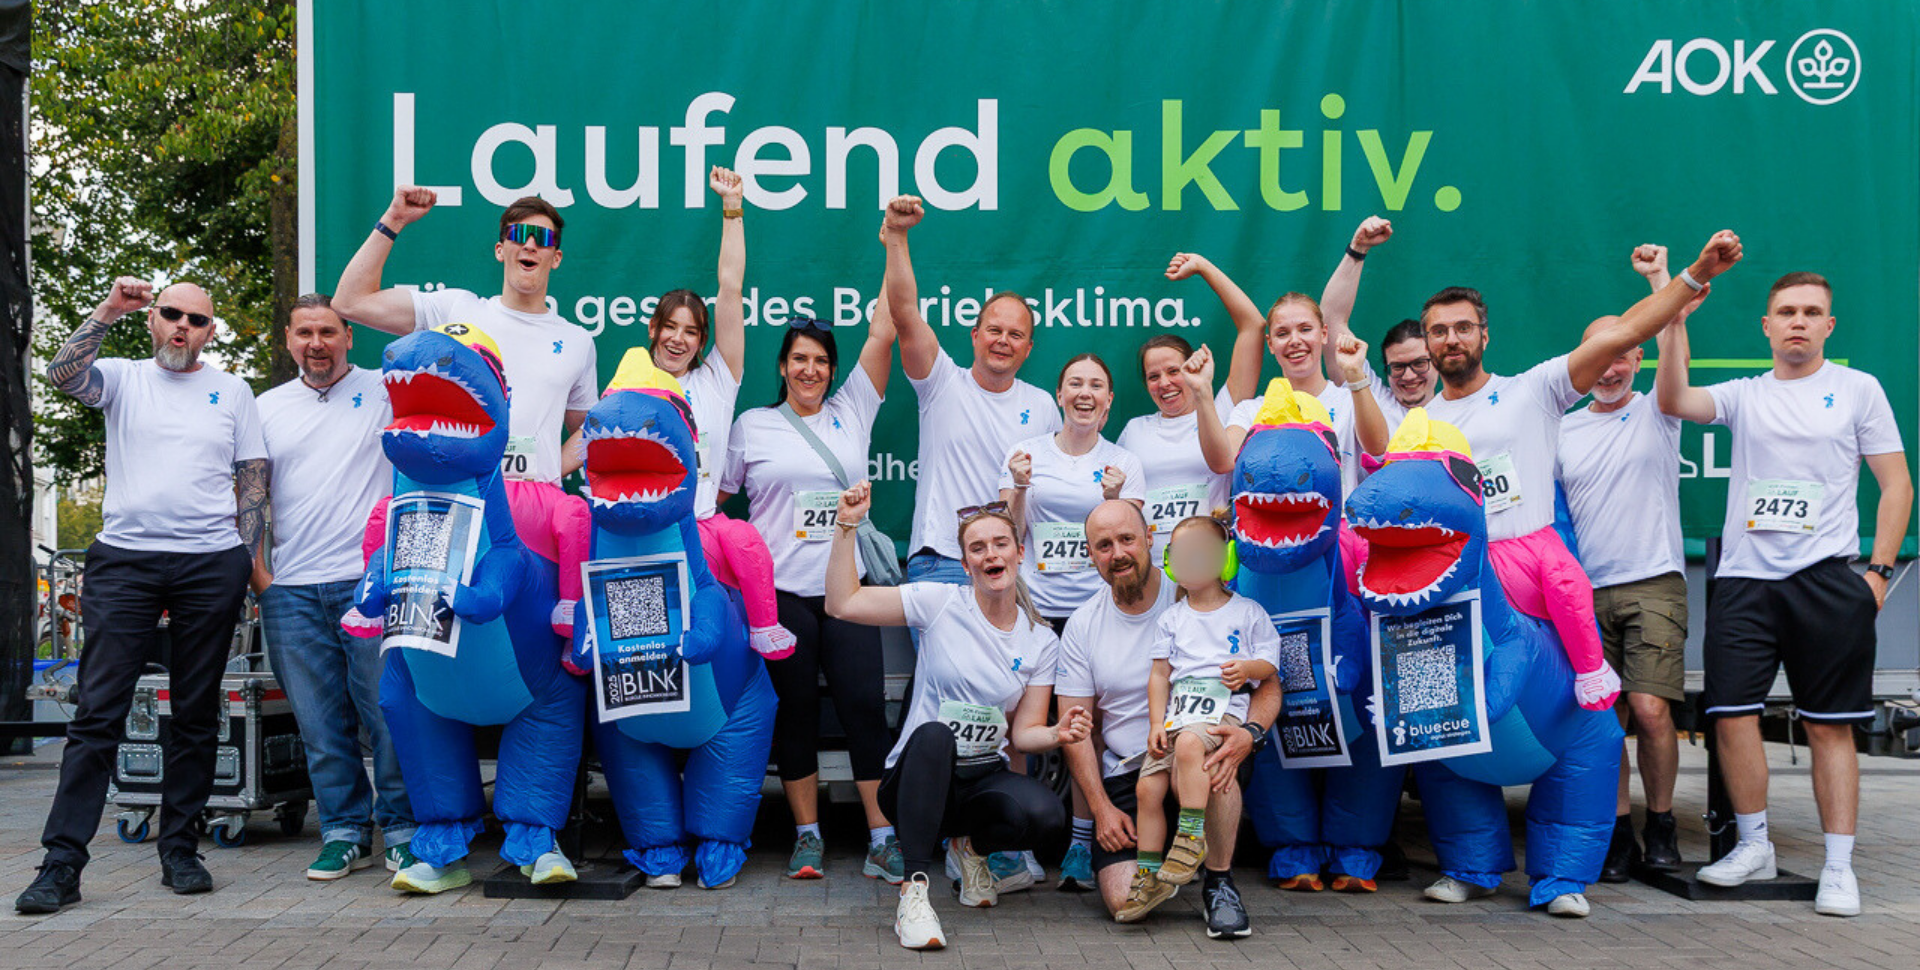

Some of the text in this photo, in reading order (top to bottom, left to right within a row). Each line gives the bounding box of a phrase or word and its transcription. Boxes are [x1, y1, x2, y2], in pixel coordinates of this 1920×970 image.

[1623, 38, 1779, 95] AOK
[393, 91, 1462, 212] Laufend aktiv.
[503, 454, 527, 474] 70
[1482, 474, 1509, 498] 80
[1152, 500, 1199, 520] 2477
[1753, 497, 1809, 519] 2473
[804, 509, 838, 528] 247
[1042, 540, 1090, 559] 2475
[393, 574, 439, 585] Kostenlos
[391, 584, 438, 595] anmelden
[1387, 611, 1464, 632] Wir begleiten Dich
[1406, 630, 1420, 638] die
[1421, 623, 1454, 636] digitale
[617, 640, 666, 653] Kostenlos
[1407, 634, 1443, 647] Zukunft.
[619, 651, 668, 664] anmelden
[608, 674, 620, 705] 2025
[949, 721, 999, 742] 2472
[1410, 718, 1470, 737] bluecue
